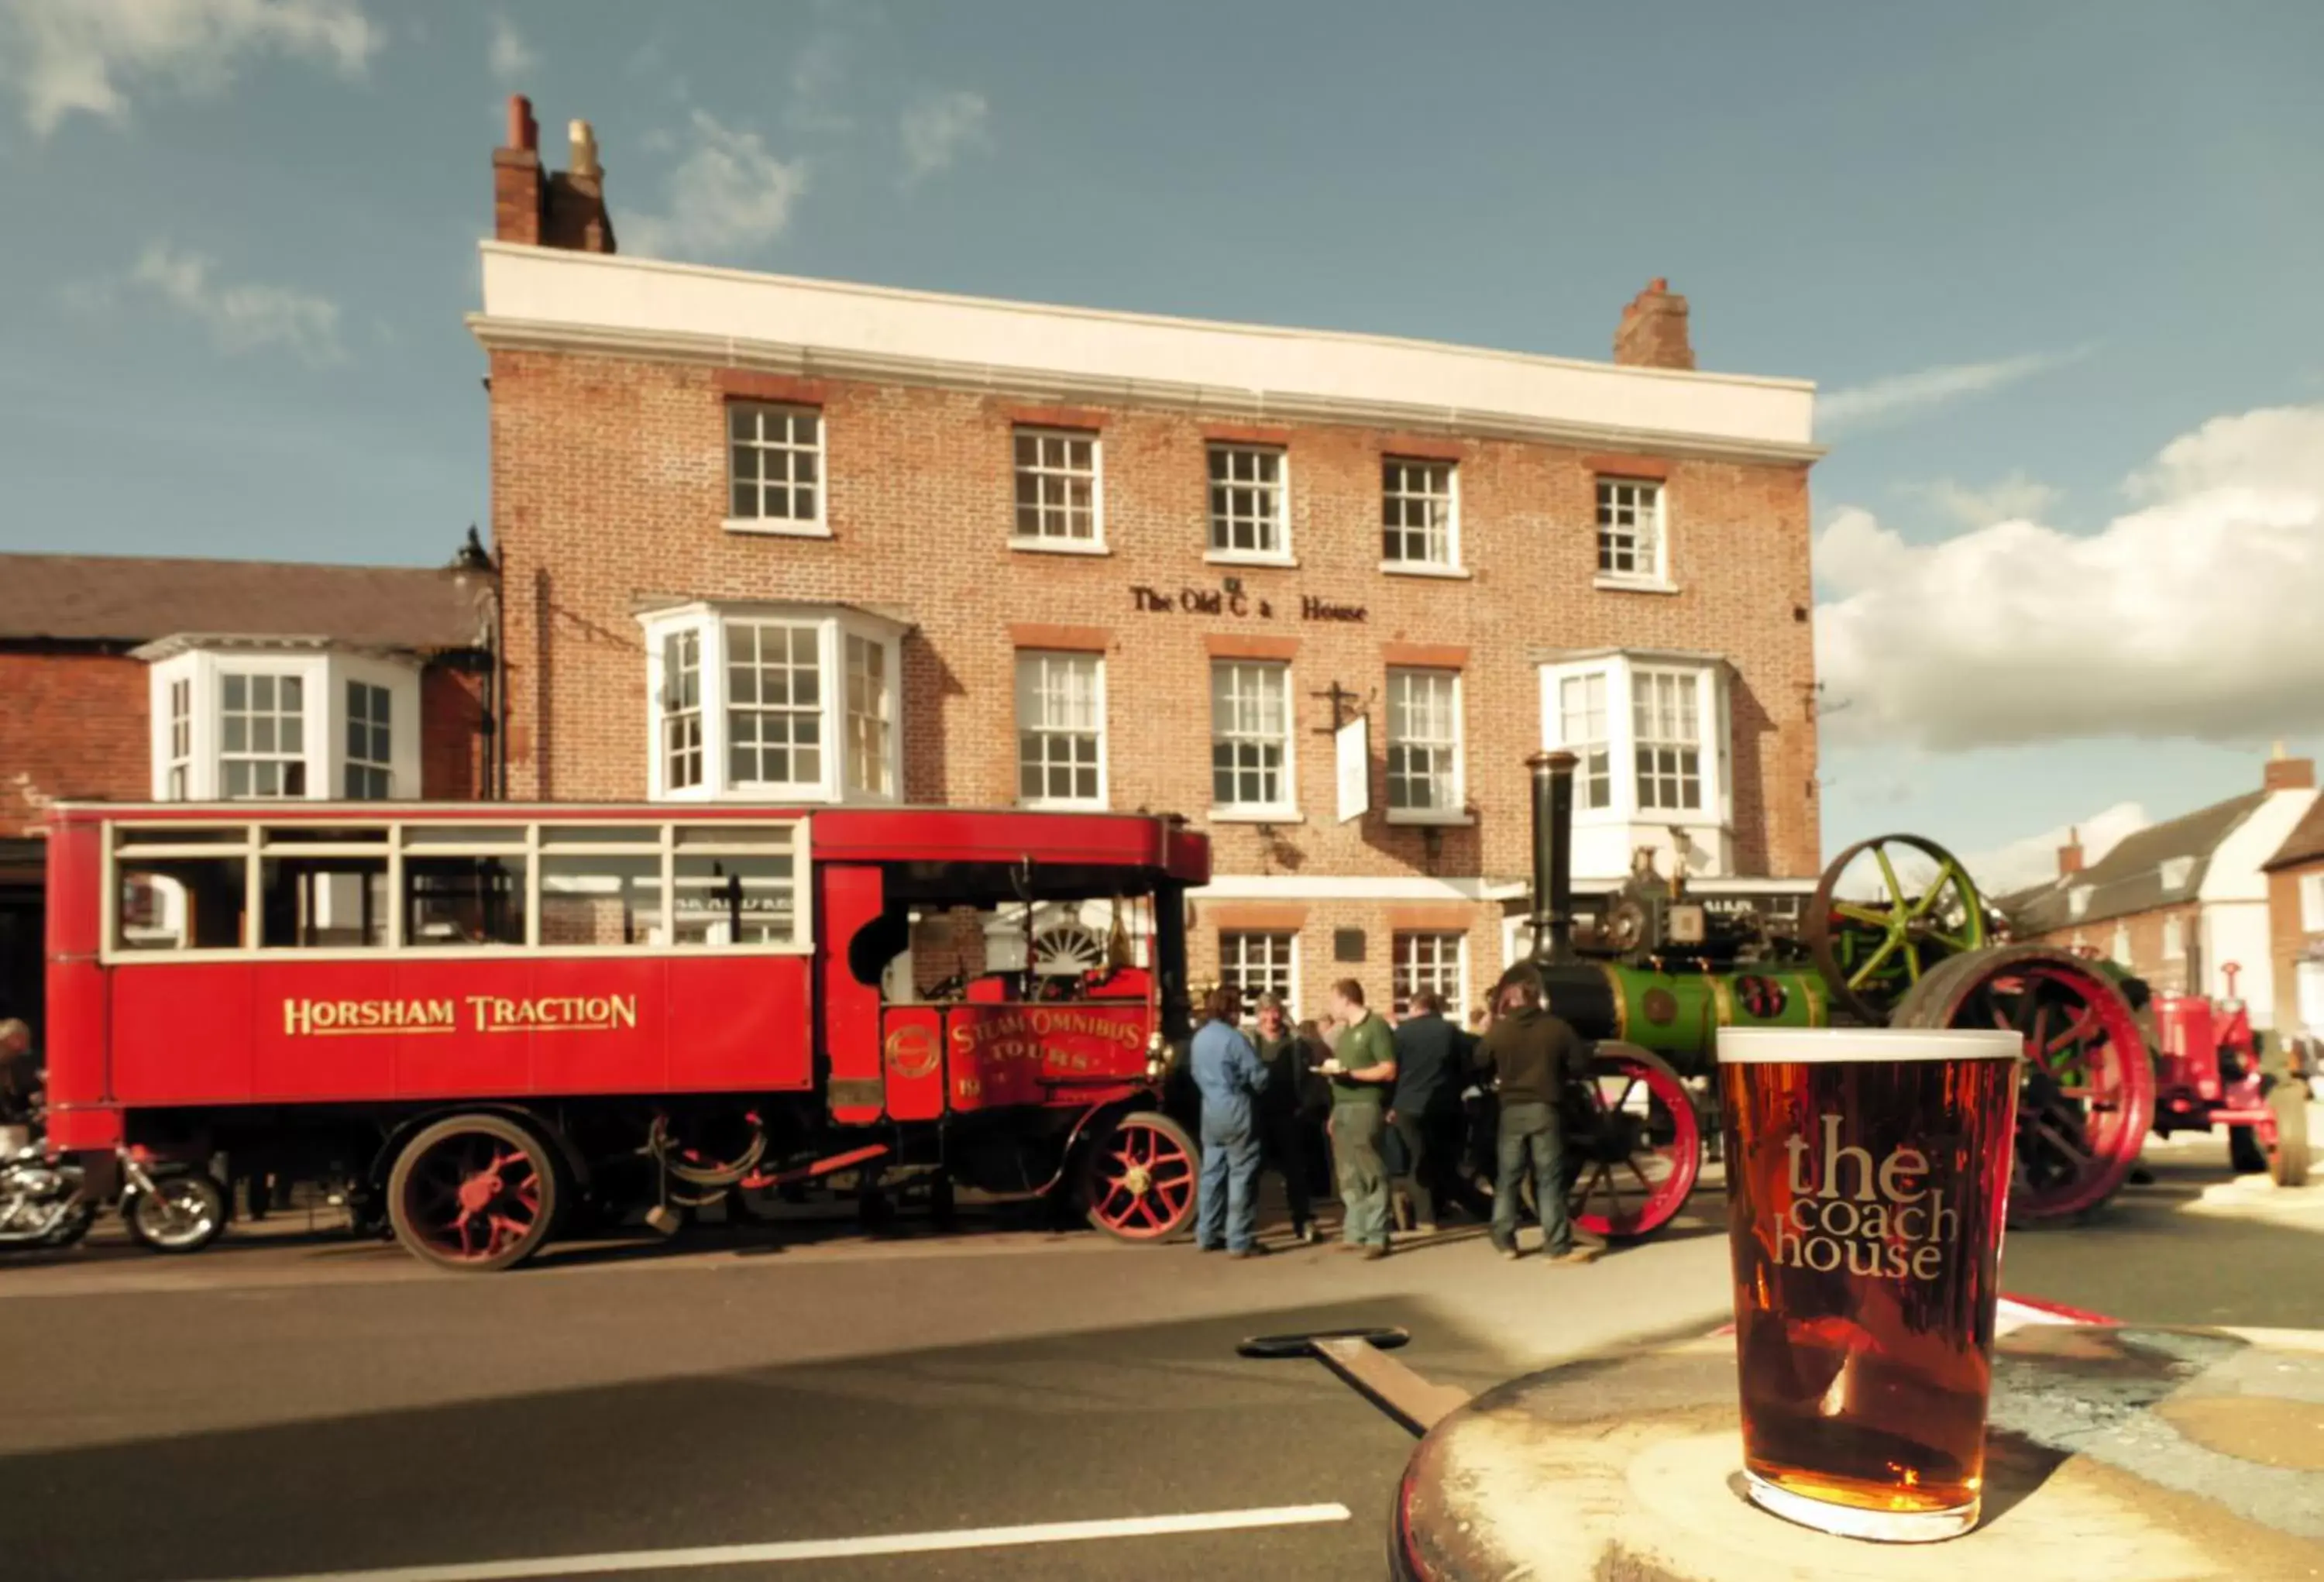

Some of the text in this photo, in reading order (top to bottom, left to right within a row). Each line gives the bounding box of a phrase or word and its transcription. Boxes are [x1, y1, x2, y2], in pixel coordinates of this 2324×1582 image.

[1130, 586, 1172, 612] The
[1181, 587, 1221, 614] Old
[1301, 595, 1367, 624] House
[284, 995, 636, 1034] HORSHAM TRACTION
[1032, 1009, 1141, 1049] OMNIBUS
[1784, 1114, 1930, 1203] the
[1792, 1189, 1958, 1243] coach
[1773, 1212, 1942, 1279] house
